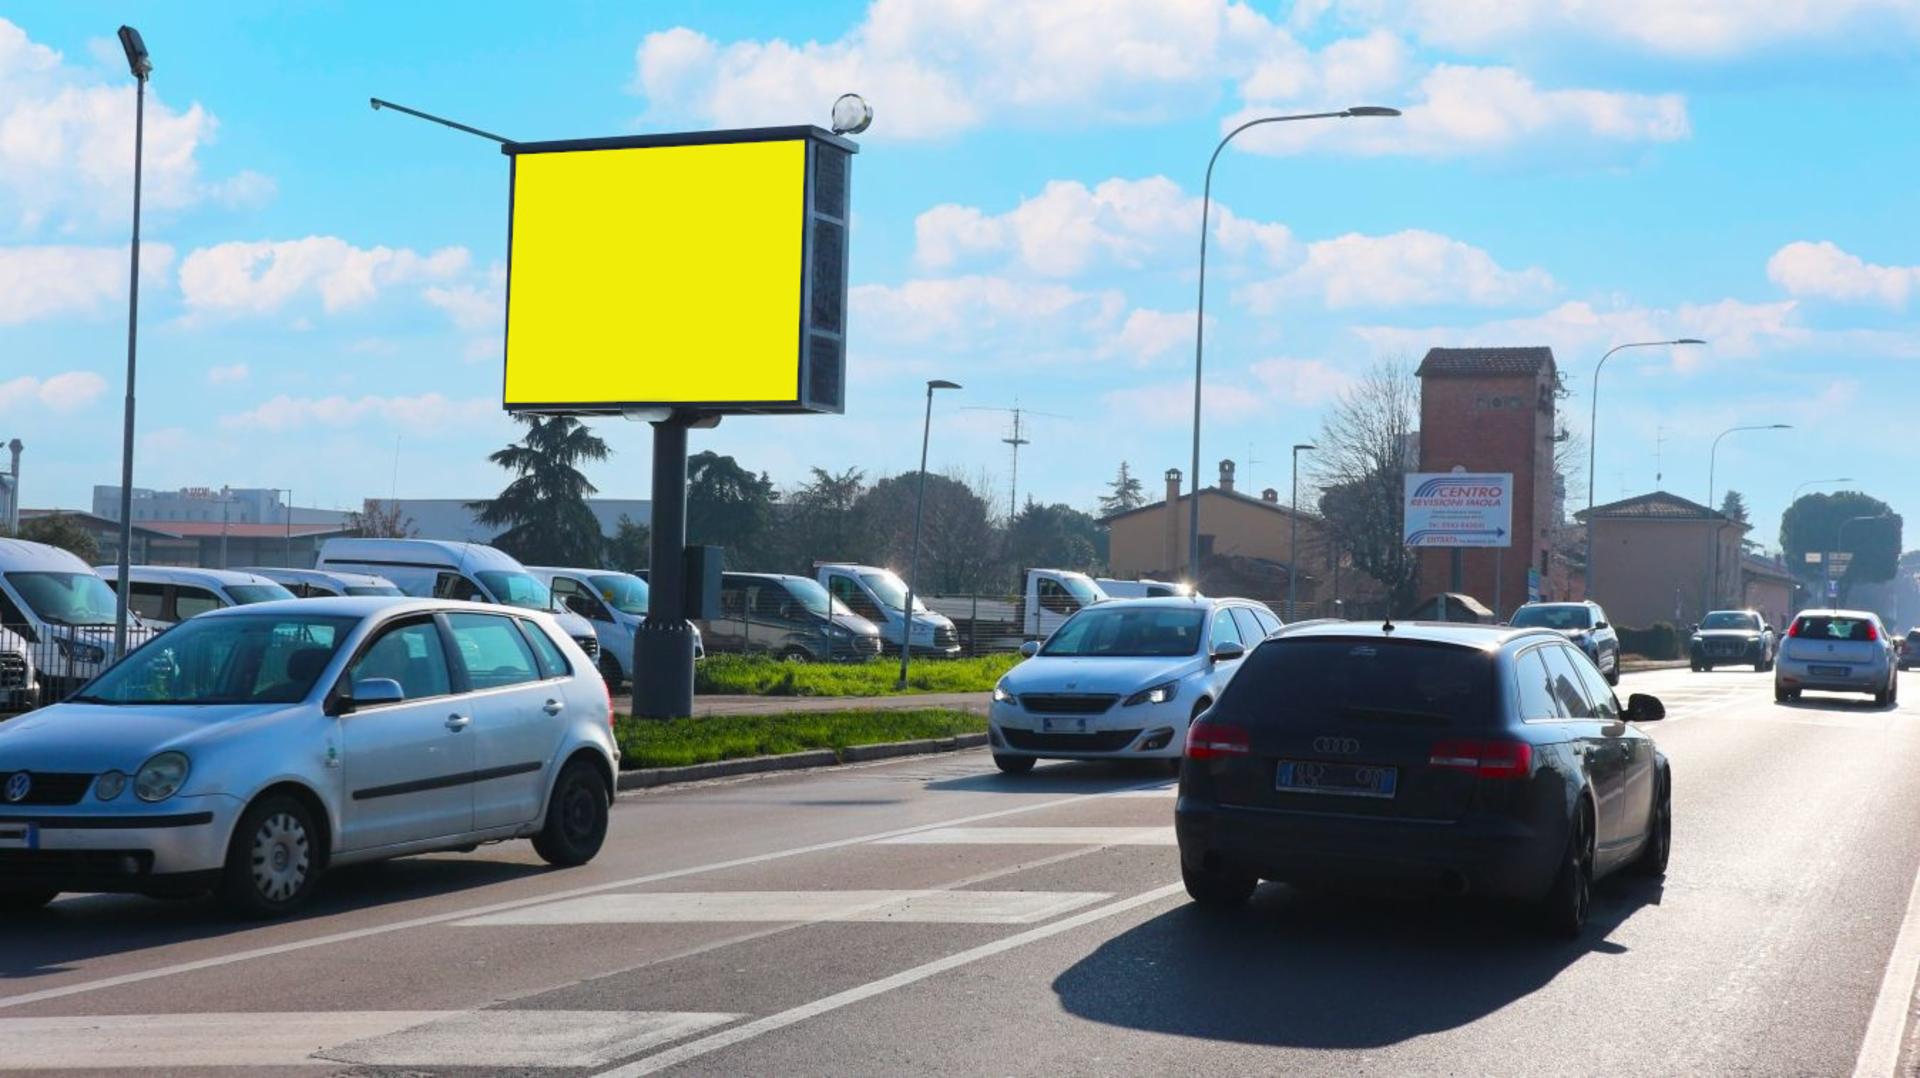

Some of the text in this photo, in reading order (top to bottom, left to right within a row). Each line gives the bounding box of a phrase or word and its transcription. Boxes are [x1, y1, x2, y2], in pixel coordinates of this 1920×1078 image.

[1439, 486, 1502, 497] CENTRO
[1411, 499, 1502, 507] REVISIONI IMOLA
